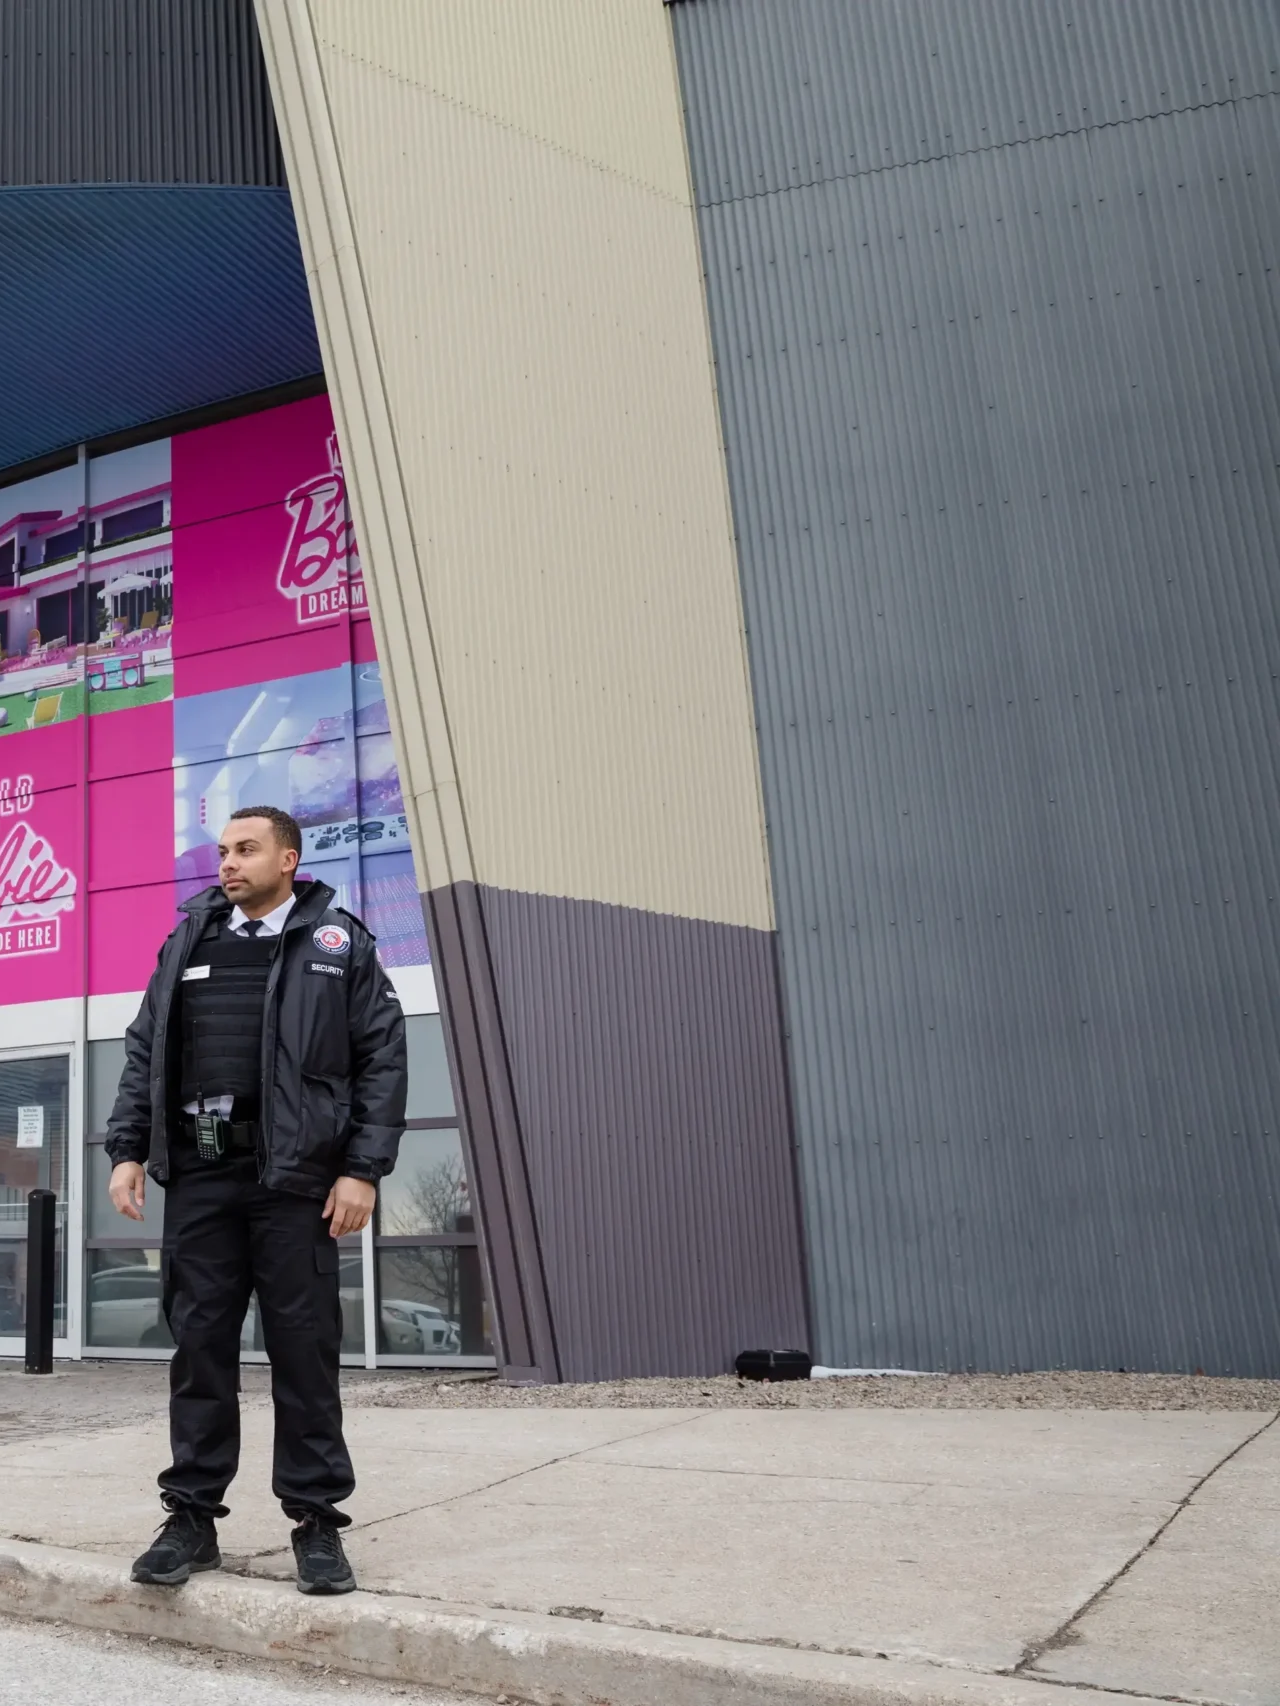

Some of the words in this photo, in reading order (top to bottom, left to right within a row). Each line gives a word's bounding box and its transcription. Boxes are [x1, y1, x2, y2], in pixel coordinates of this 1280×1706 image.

[308, 584, 364, 614] DREAM
[18, 925, 52, 950] HERE
[311, 963, 345, 977] SECURITY
